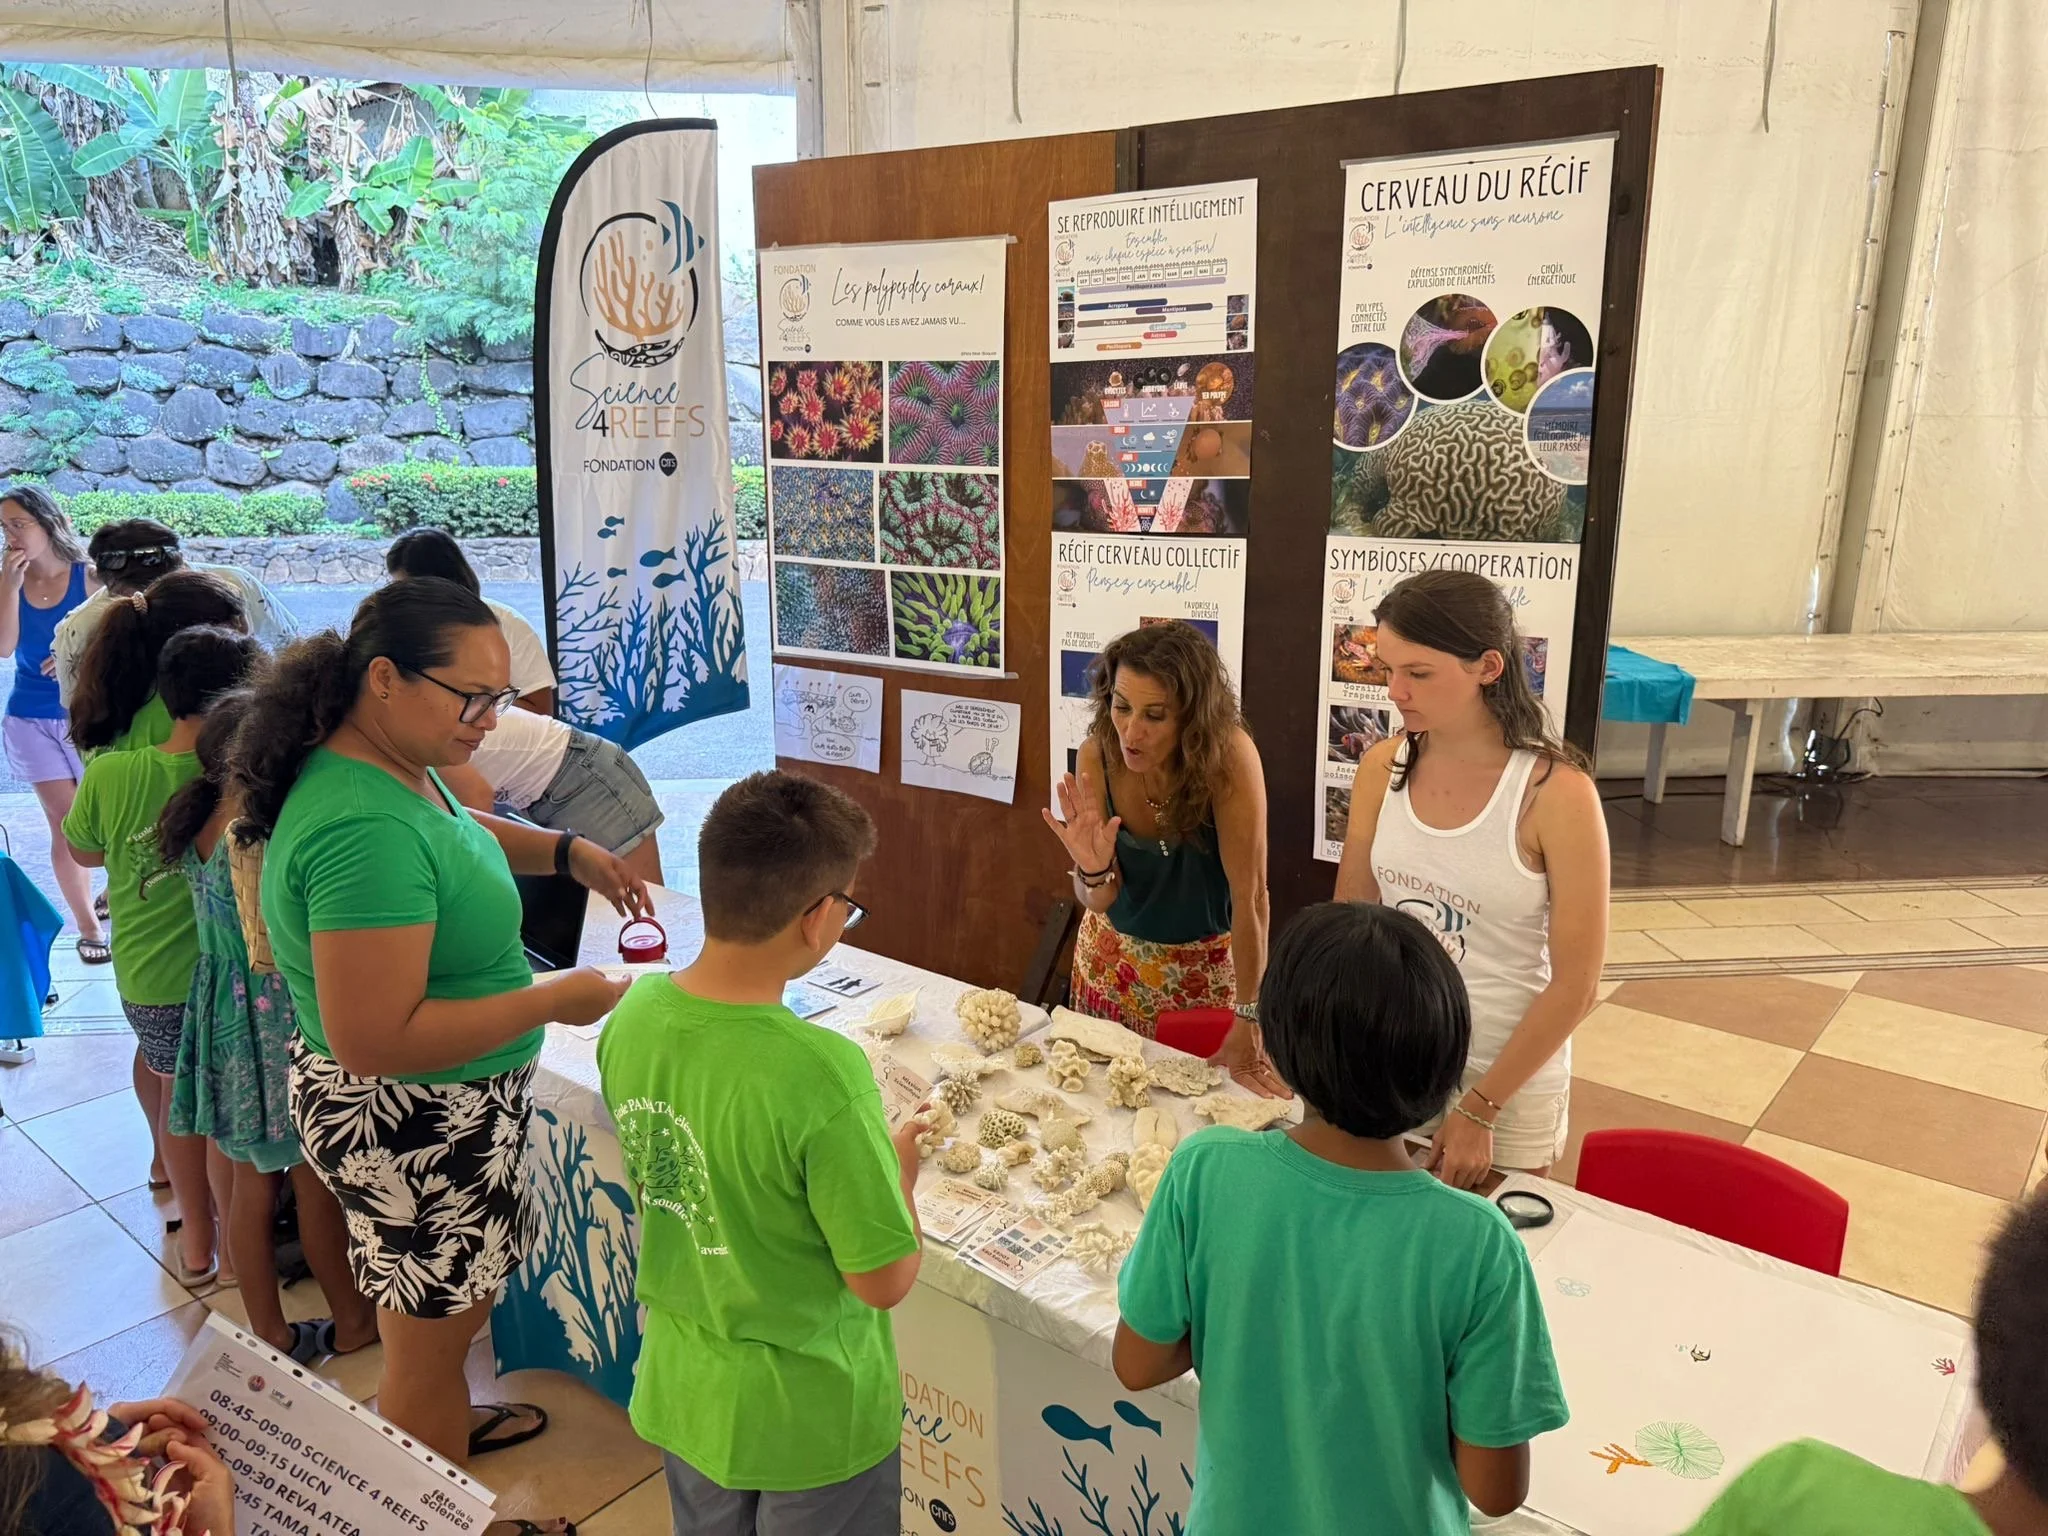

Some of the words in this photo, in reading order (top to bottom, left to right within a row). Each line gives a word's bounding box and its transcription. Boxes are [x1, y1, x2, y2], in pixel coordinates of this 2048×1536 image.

[1361, 172, 1468, 212] CERVEAU
[1477, 168, 1511, 202] DU
[1520, 155, 1590, 198] RÉCIF
[1057, 216, 1070, 234] SE
[1073, 207, 1145, 232] REPRODUIRE
[1149, 197, 1244, 224] INTÉLLIGEMENT
[1384, 212, 1469, 240] L'intelligence
[1469, 216, 1504, 232] sans
[1507, 208, 1564, 224] neurone
[773, 264, 816, 275] FONDATION
[1407, 277, 1446, 289] EXPULSION
[1447, 276, 1456, 286] DE
[1457, 273, 1496, 286] FILAMENTS
[1540, 261, 1564, 275] CHOIX
[832, 268, 861, 305] Les
[1355, 302, 1384, 312] POLYPES
[835, 318, 863, 327] COMME
[864, 318, 885, 327] VOUS
[886, 318, 900, 326] LES
[901, 318, 919, 326] AVEZ
[920, 318, 948, 326] JAMAIS
[949, 317, 966, 326] VU...
[1351, 323, 1371, 333] ENTRE
[1373, 323, 1386, 332] EUX
[570, 353, 680, 430] Science
[592, 405, 705, 439] 4REEFS
[1539, 442, 1558, 452] LEUR
[583, 459, 655, 473] FONDATION
[1059, 539, 1094, 564] RÉCIF
[1097, 544, 1161, 566] CERVEAU
[1166, 544, 1240, 569] COLLECTIF
[1087, 568, 1134, 595] Pensez
[1212, 602, 1218, 610] LA
[1073, 632, 1095, 640] PRODUIT
[1377, 866, 1481, 914] FONDATION
[652, 1198, 688, 1221] souffle
[290, 1463, 332, 1497] UICN
[301, 1445, 369, 1493] SCIENCE
[369, 1489, 381, 1501] 4
[381, 1496, 429, 1533] REEFS
[275, 1483, 317, 1517] REVA
[320, 1511, 361, 1536] ATEA
[420, 1493, 470, 1531] Science
[431, 1489, 456, 1511] fête
[455, 1508, 466, 1518] de
[930, 1503, 955, 1527] cnrs
[263, 1502, 310, 1536] TAMA
